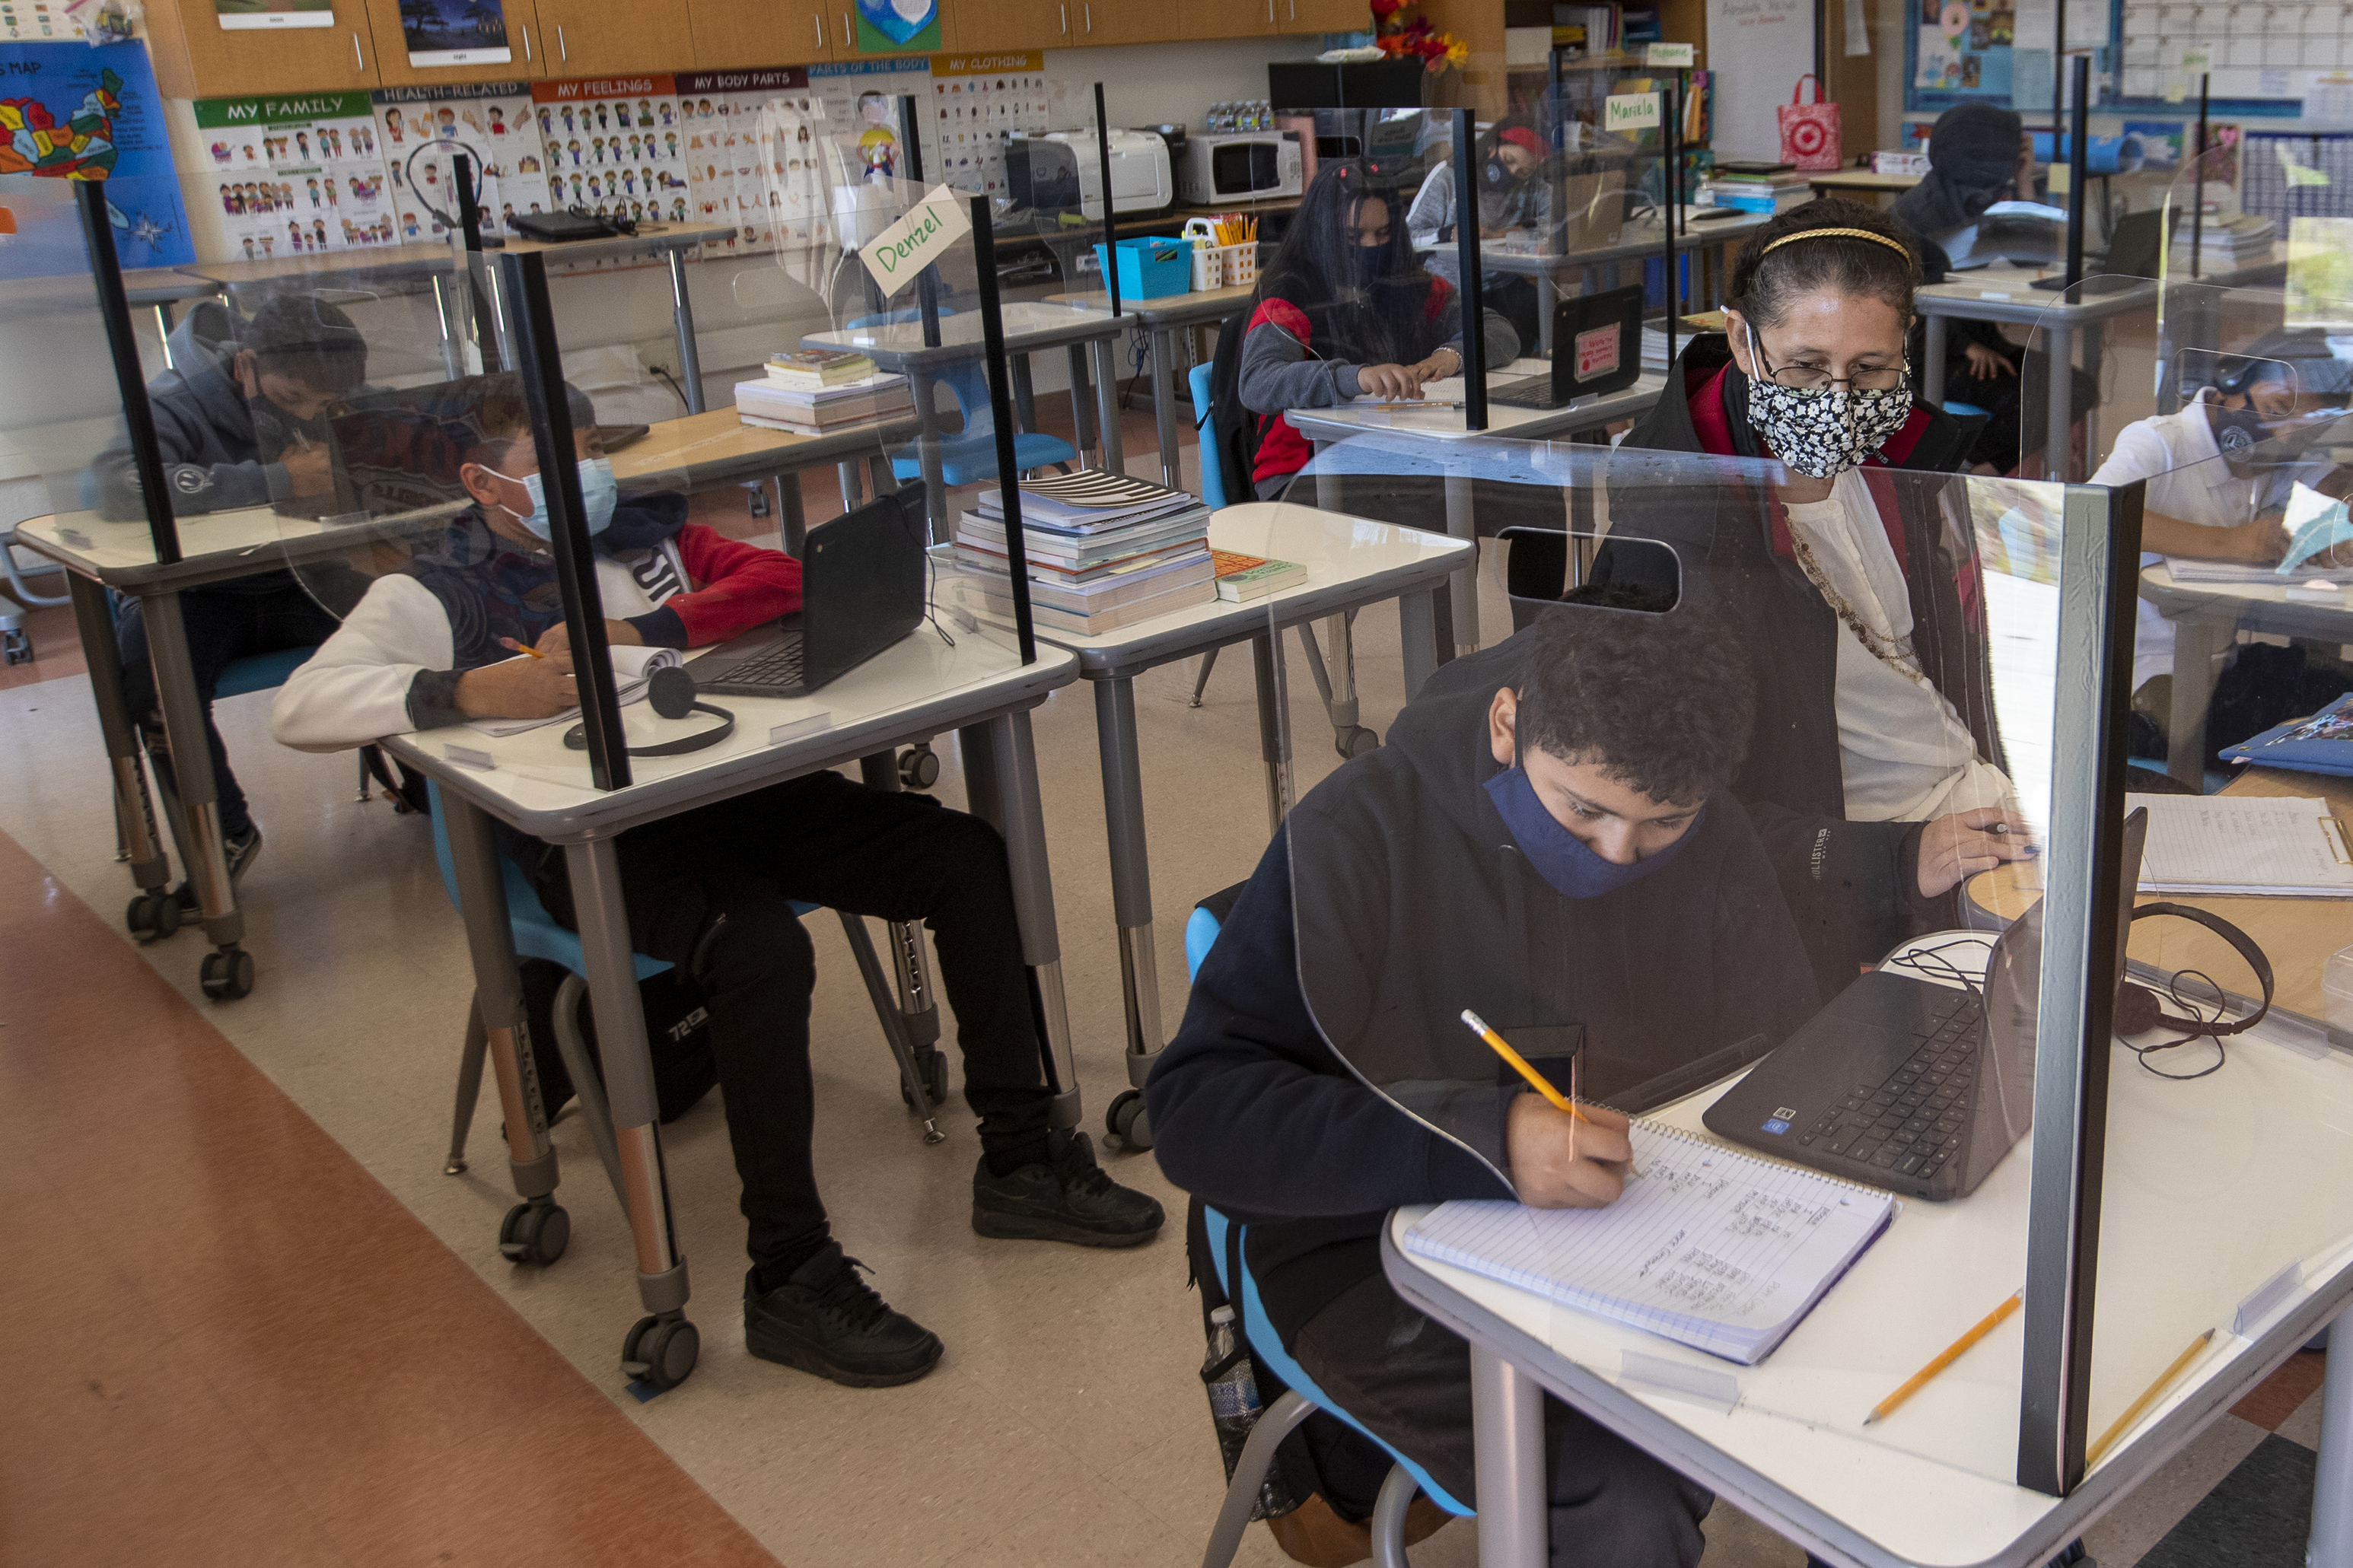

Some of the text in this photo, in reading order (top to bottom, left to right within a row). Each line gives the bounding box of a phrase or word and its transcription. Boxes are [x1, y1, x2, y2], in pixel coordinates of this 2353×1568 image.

[8, 62, 41, 75] MAP
[950, 55, 1027, 71] MY CLOTHING
[384, 81, 517, 101] HEALTH-RELATED
[558, 78, 652, 98] MY FEELINGS
[695, 72, 791, 90] MY BODY PARTS
[228, 97, 343, 120] MY FAMILY
[875, 205, 944, 274] Denzel
[1810, 837, 1826, 880] HOLLISTER
